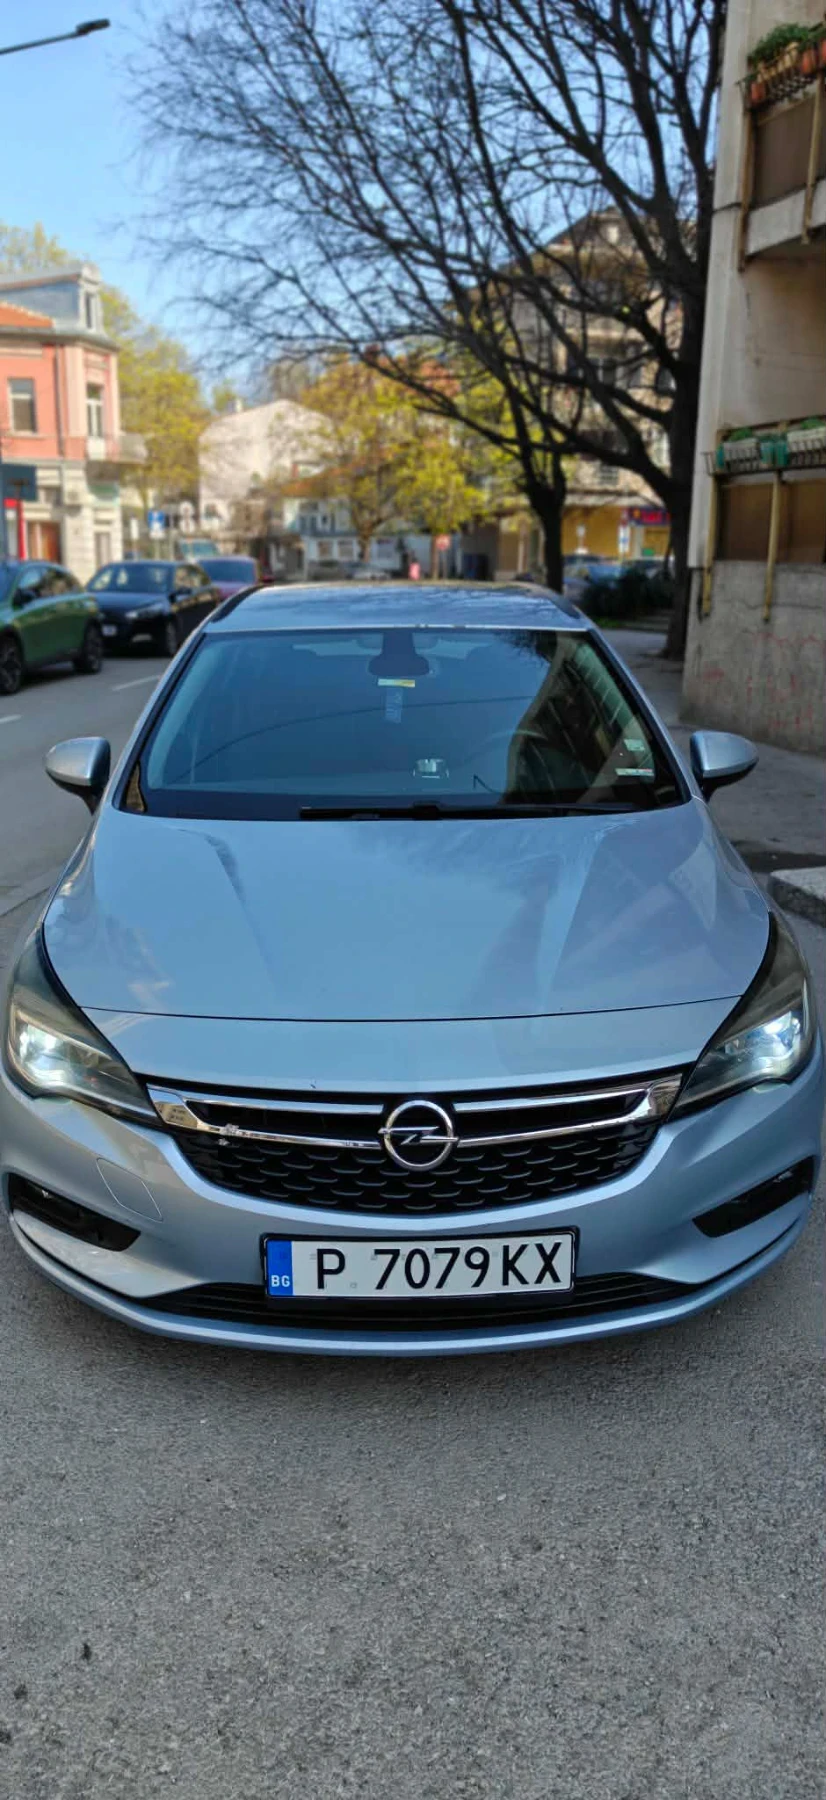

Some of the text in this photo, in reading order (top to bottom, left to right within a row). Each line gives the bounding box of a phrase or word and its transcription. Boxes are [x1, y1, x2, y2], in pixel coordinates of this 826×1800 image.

[271, 1274, 291, 1288] BG
[316, 1248, 346, 1290] P
[374, 1246, 491, 1290] 7079
